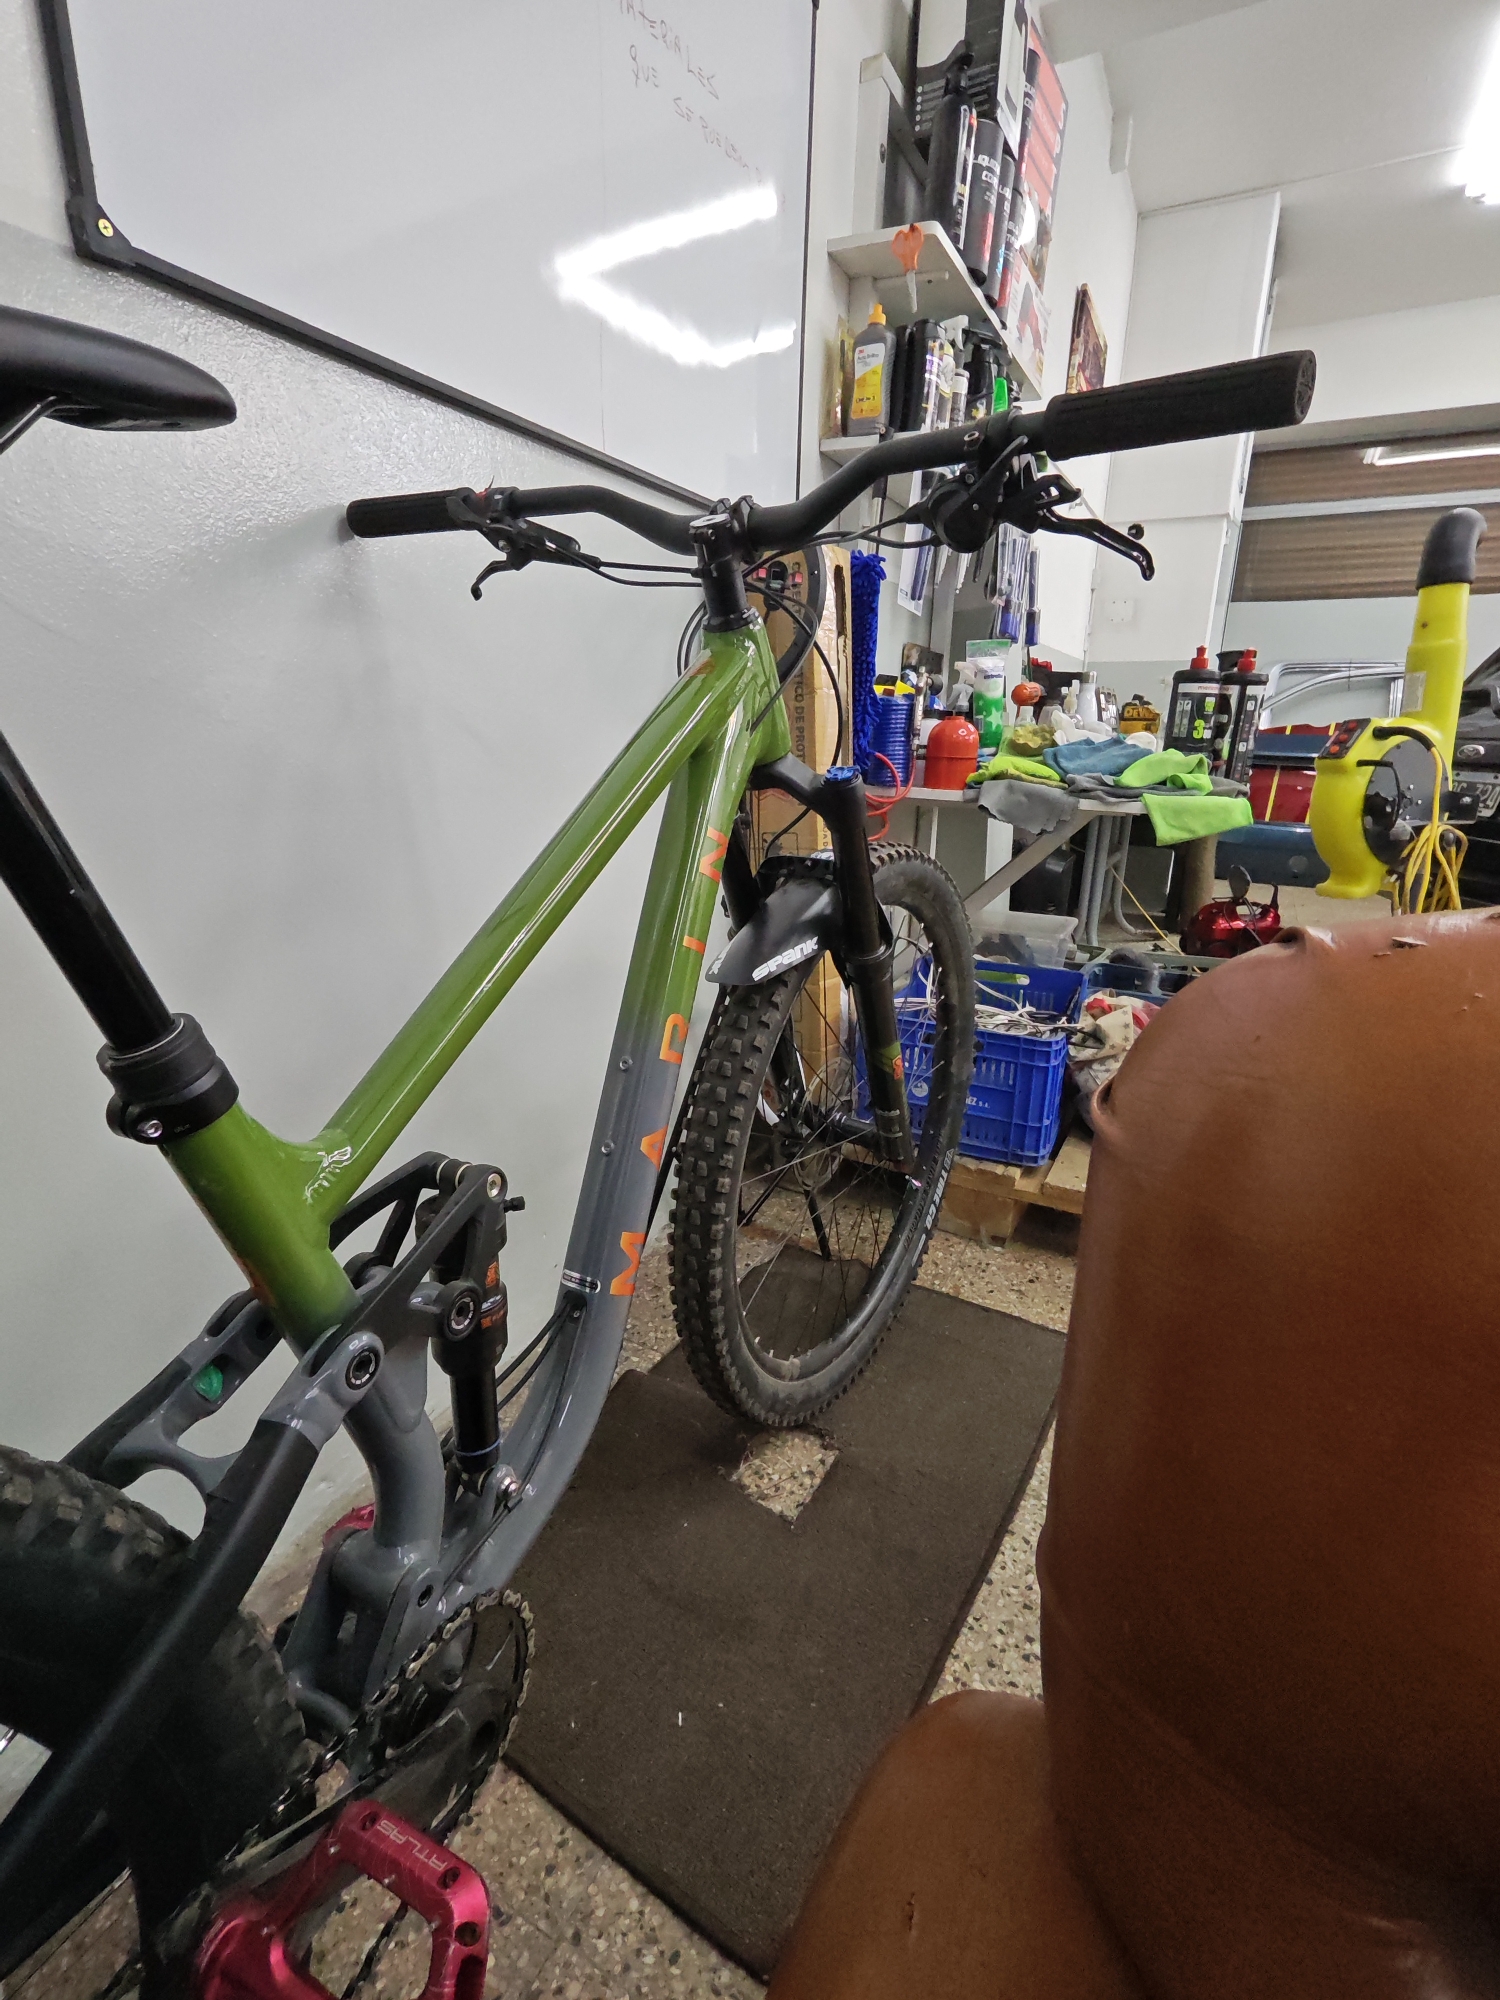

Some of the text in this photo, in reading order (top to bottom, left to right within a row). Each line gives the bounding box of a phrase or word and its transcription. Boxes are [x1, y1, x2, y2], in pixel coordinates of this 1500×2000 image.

[793, 706, 806, 724] DE
[794, 727, 806, 763] PROT
[609, 826, 731, 1297] MARIN
[376, 1819, 448, 1872] ATLAS
